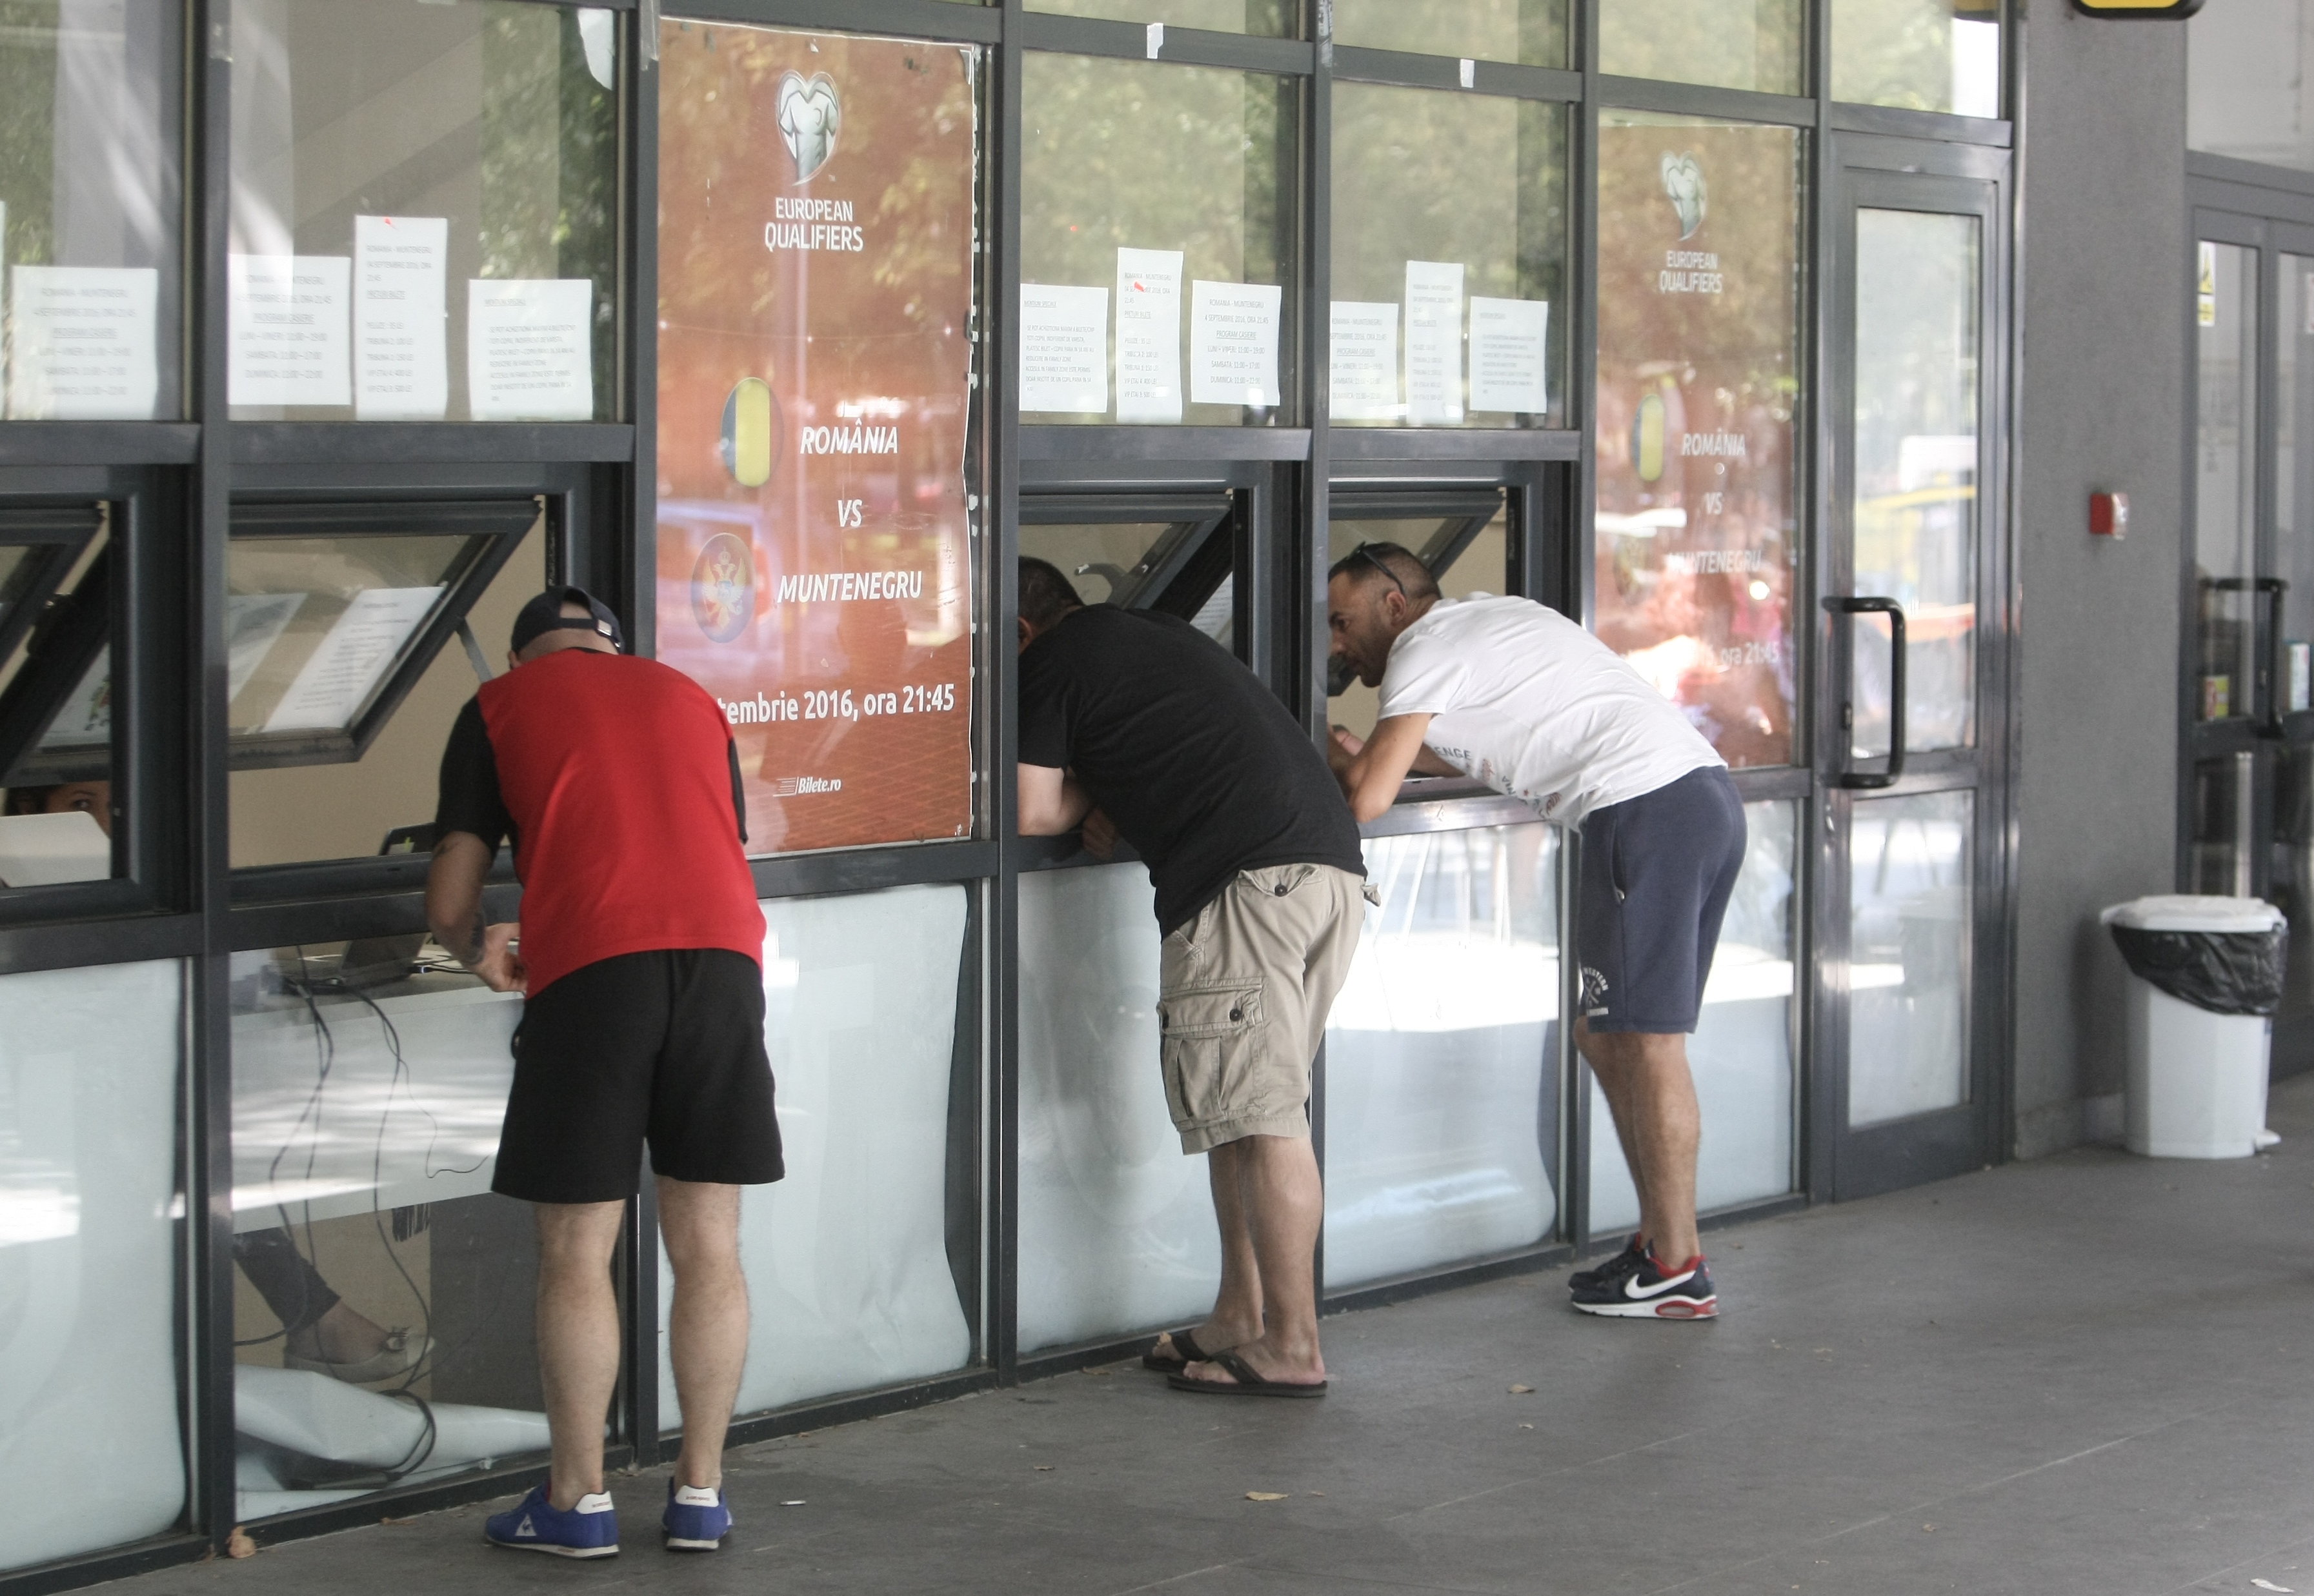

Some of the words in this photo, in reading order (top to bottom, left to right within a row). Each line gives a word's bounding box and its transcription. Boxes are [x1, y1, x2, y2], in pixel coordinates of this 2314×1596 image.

[776, 197, 854, 222] EUROPEAN
[765, 226, 864, 252] QUALIFIERS
[1667, 250, 1718, 269] EUROPEAN
[1659, 270, 1723, 294] QUALIFIERS
[1234, 300, 1264, 308] MUNTENEGRU
[1208, 314, 1234, 323] SEPTEMBRIE
[800, 418, 898, 454] ROMÂNIA
[1681, 428, 1746, 457] ROMÂNIA
[838, 499, 863, 528] VS
[1704, 492, 1723, 515] VS
[1668, 550, 1762, 574] MUNTENEGRU
[778, 571, 923, 603] MUNTENEGRU
[804, 690, 859, 721] 2016,
[863, 693, 897, 715] ora
[903, 683, 955, 713] 21:45
[798, 775, 842, 794] Bilete.ro
